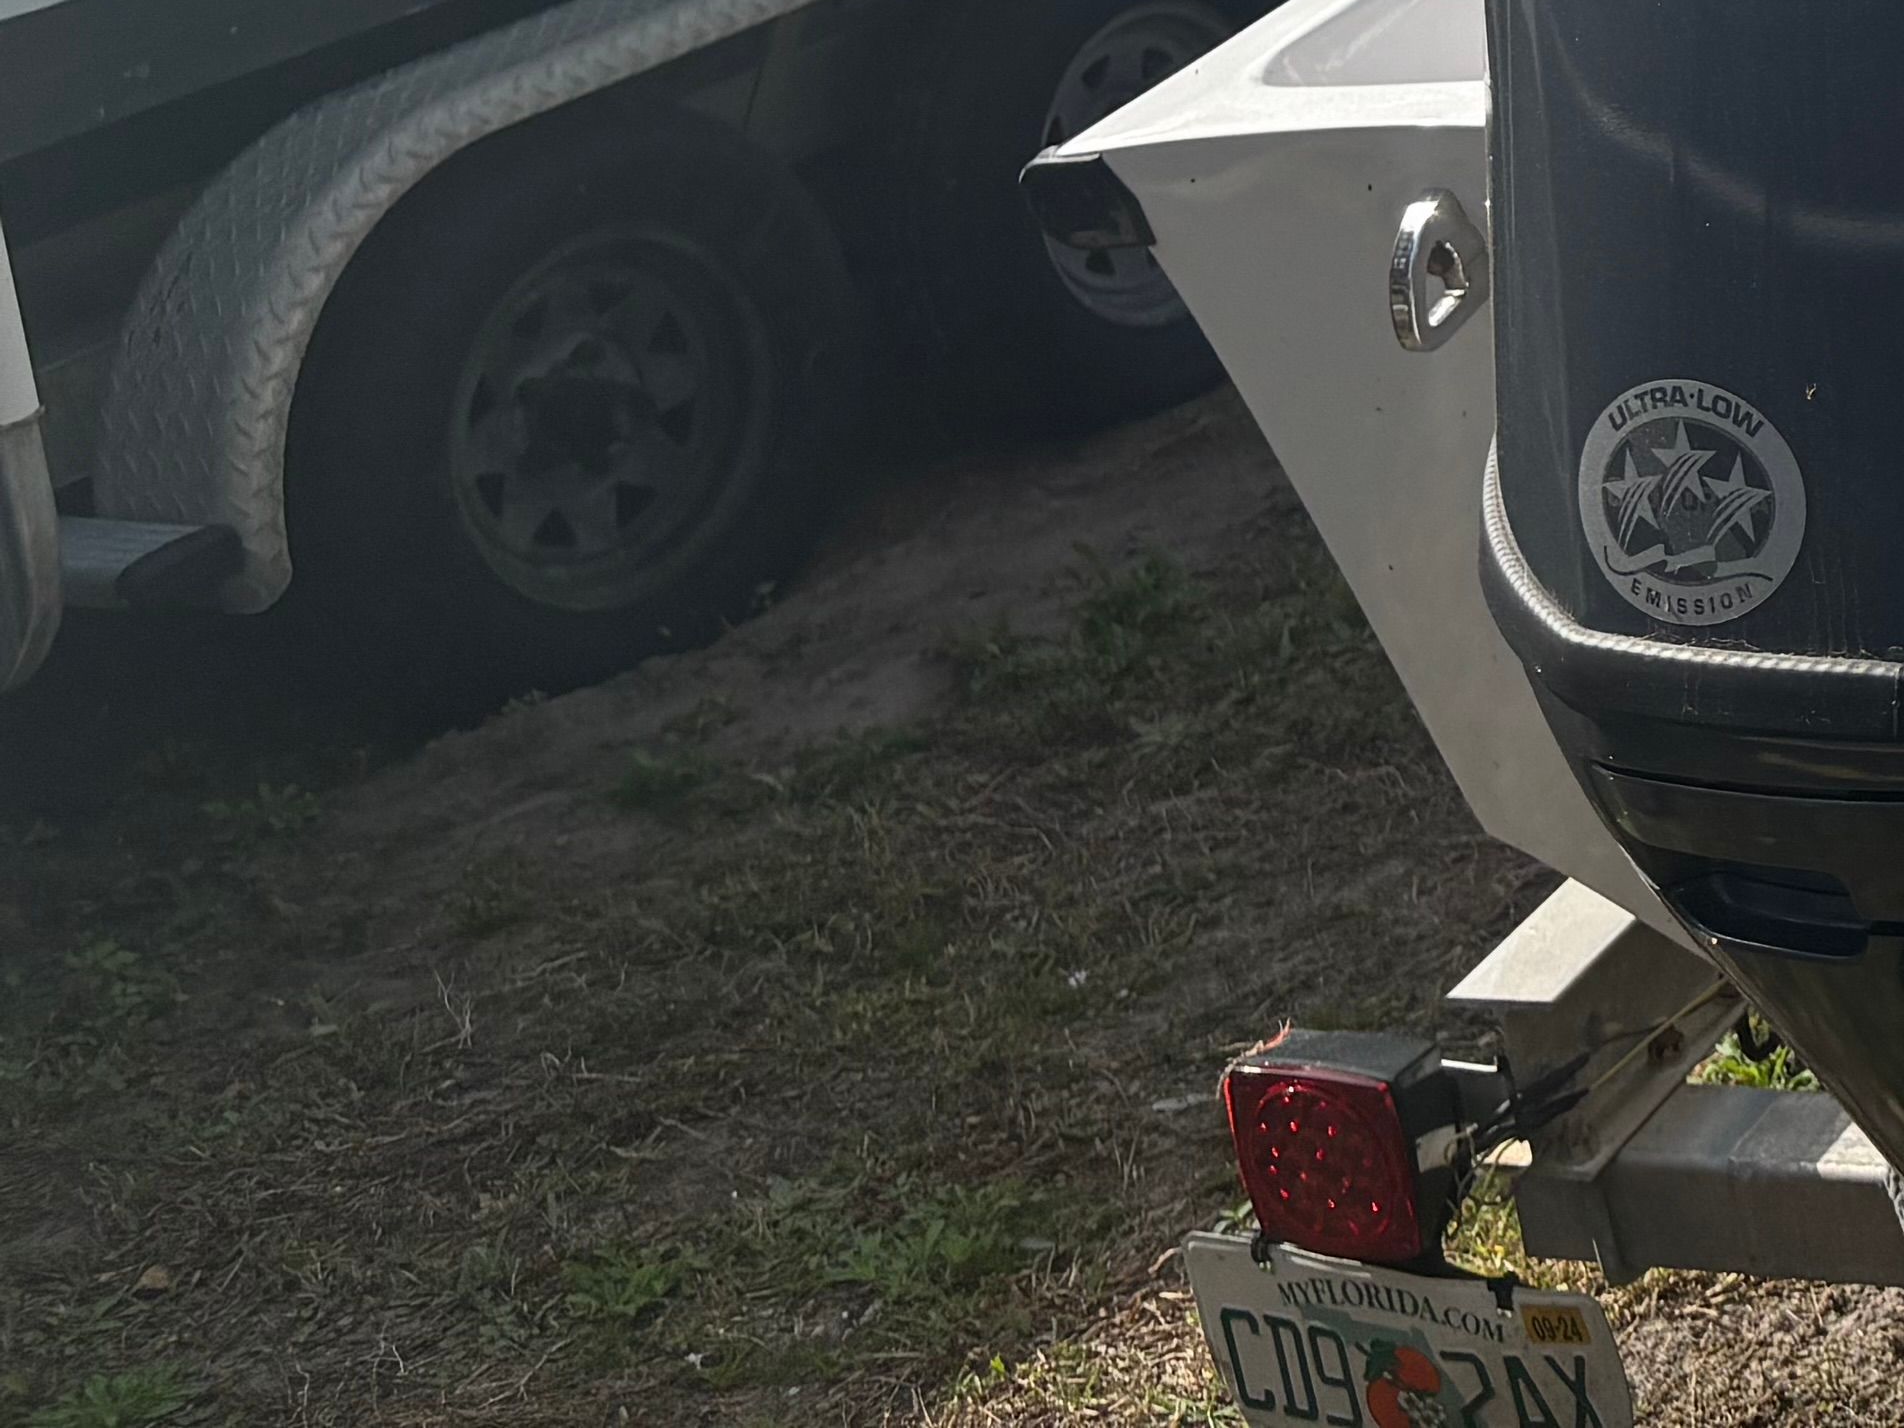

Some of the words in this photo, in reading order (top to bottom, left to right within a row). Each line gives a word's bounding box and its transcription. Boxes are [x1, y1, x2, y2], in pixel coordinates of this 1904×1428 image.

[1630, 576, 1753, 616] EMISSION
[1276, 1278, 1505, 1344] MYFLORIDA.COM
[1220, 1306, 1363, 1428] CD9
